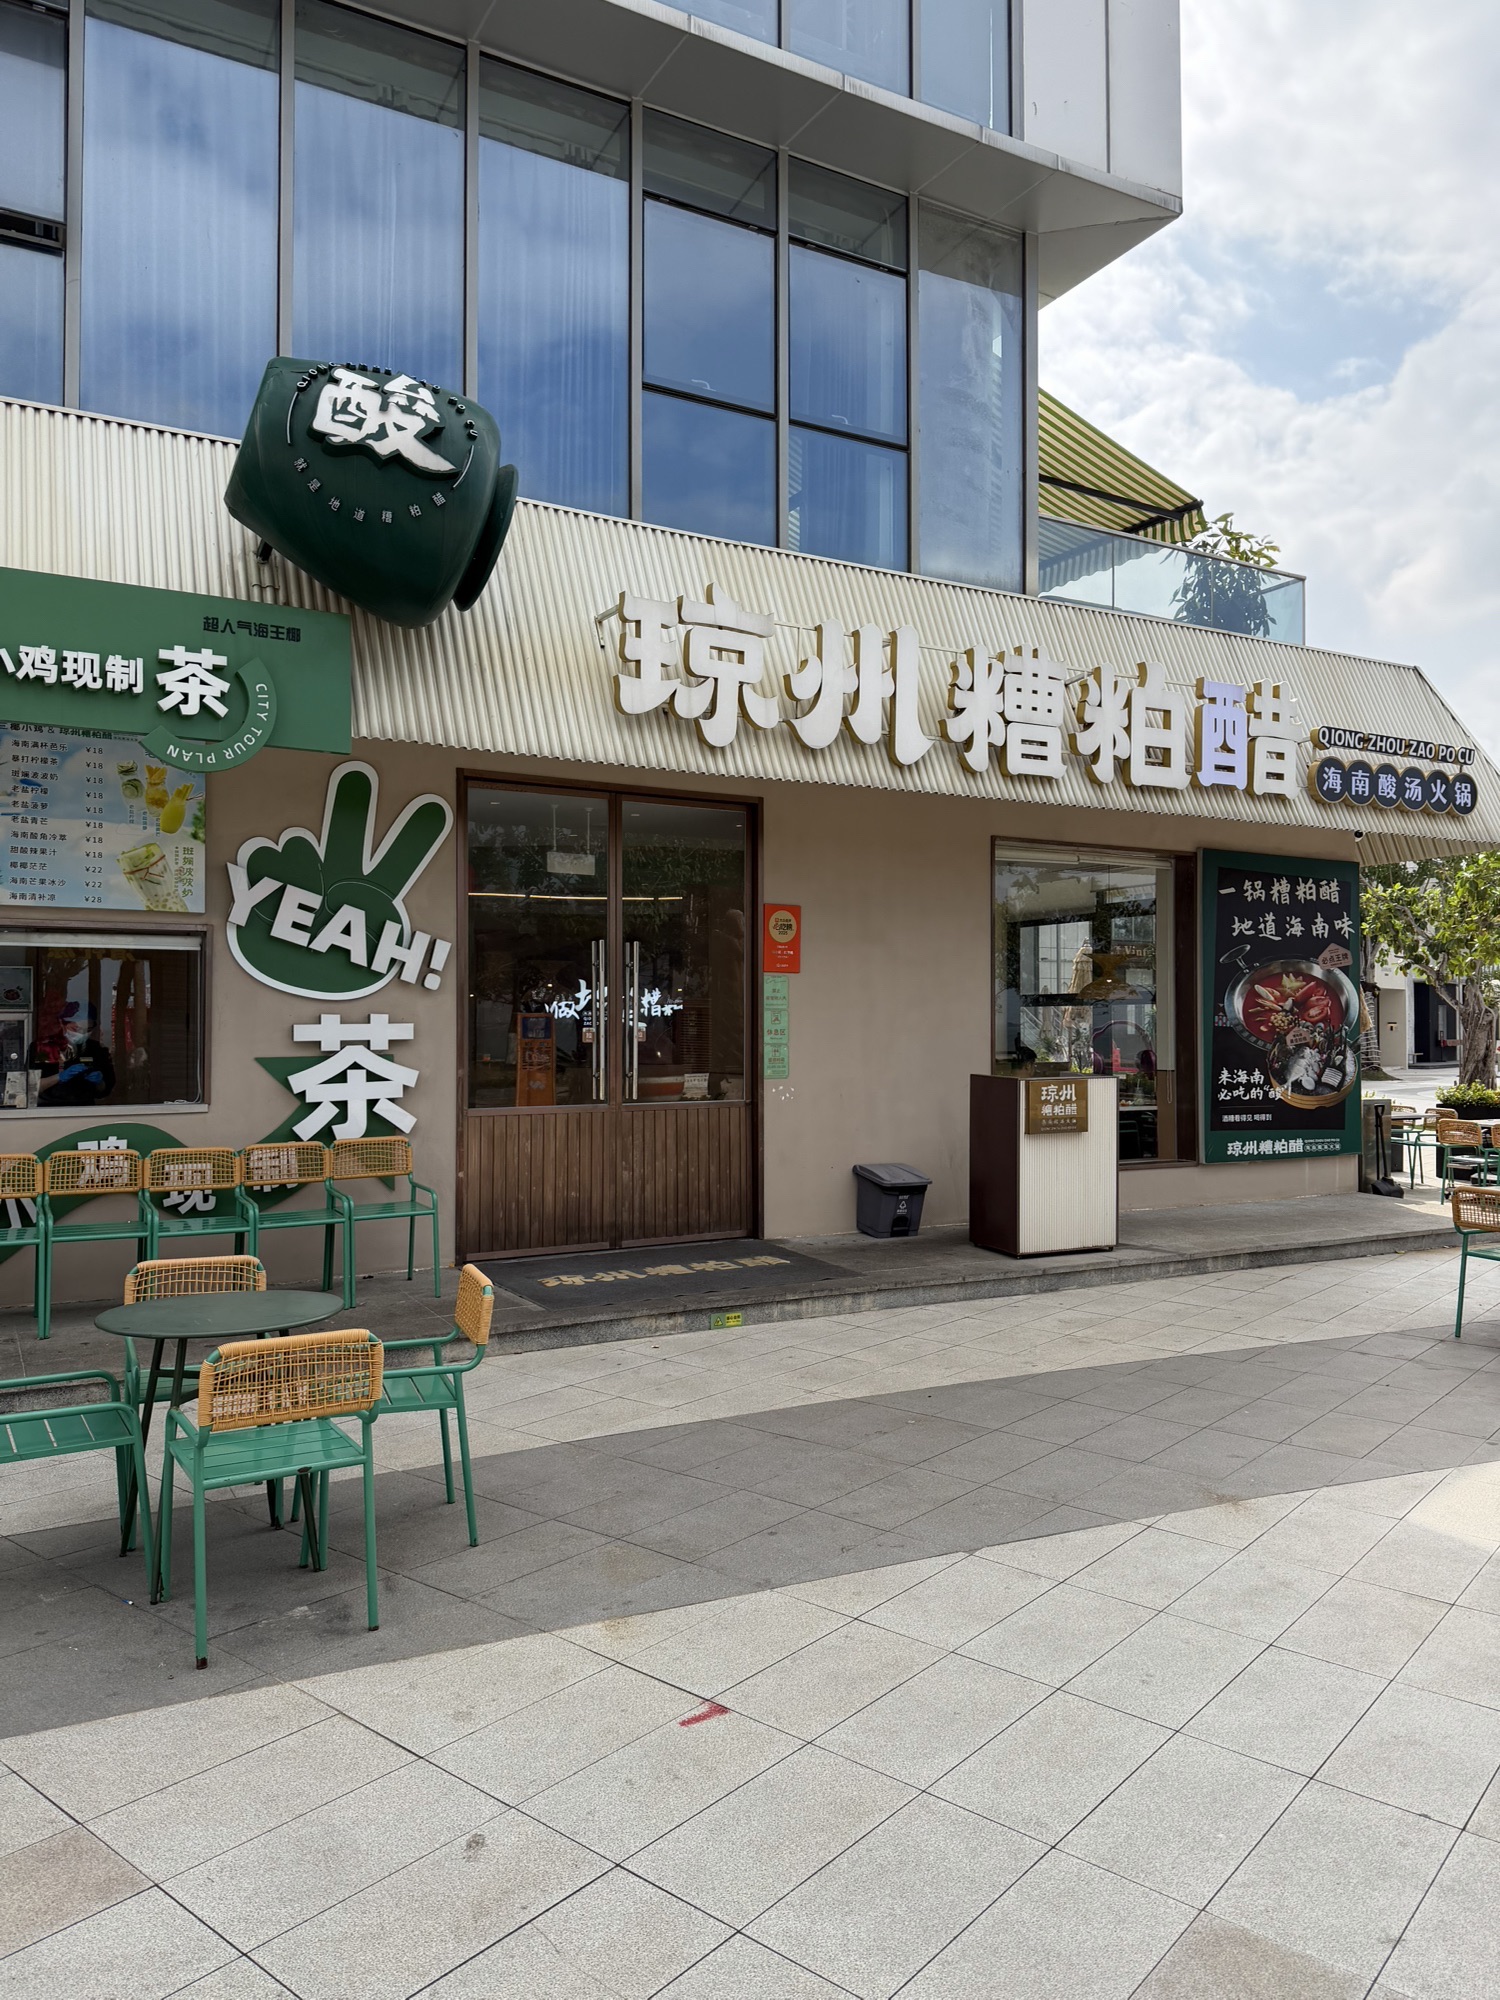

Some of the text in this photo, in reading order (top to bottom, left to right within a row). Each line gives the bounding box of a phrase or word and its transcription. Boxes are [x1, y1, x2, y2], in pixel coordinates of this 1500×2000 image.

[203, 616, 302, 643] 超人气海王椰
[0, 644, 231, 718] 鸡现制茶
[612, 580, 1304, 800] 琼州糟粕醋
[166, 683, 270, 765] CITY TOUR PLAN
[1319, 726, 1475, 765] QIONG ZHOU ZAO PO CU
[1322, 766, 1472, 808] 海南酸汤火锅
[1218, 876, 1341, 905] 一锅糟粕醋
[226, 861, 452, 991] YEAH!
[1231, 911, 1355, 941] 地道海南味
[287, 1013, 420, 1142] 茶
[1041, 1083, 1077, 1103] 琼州
[1217, 1066, 1265, 1086] 来海南
[1226, 1137, 1304, 1157] 琼州糟粕醋
